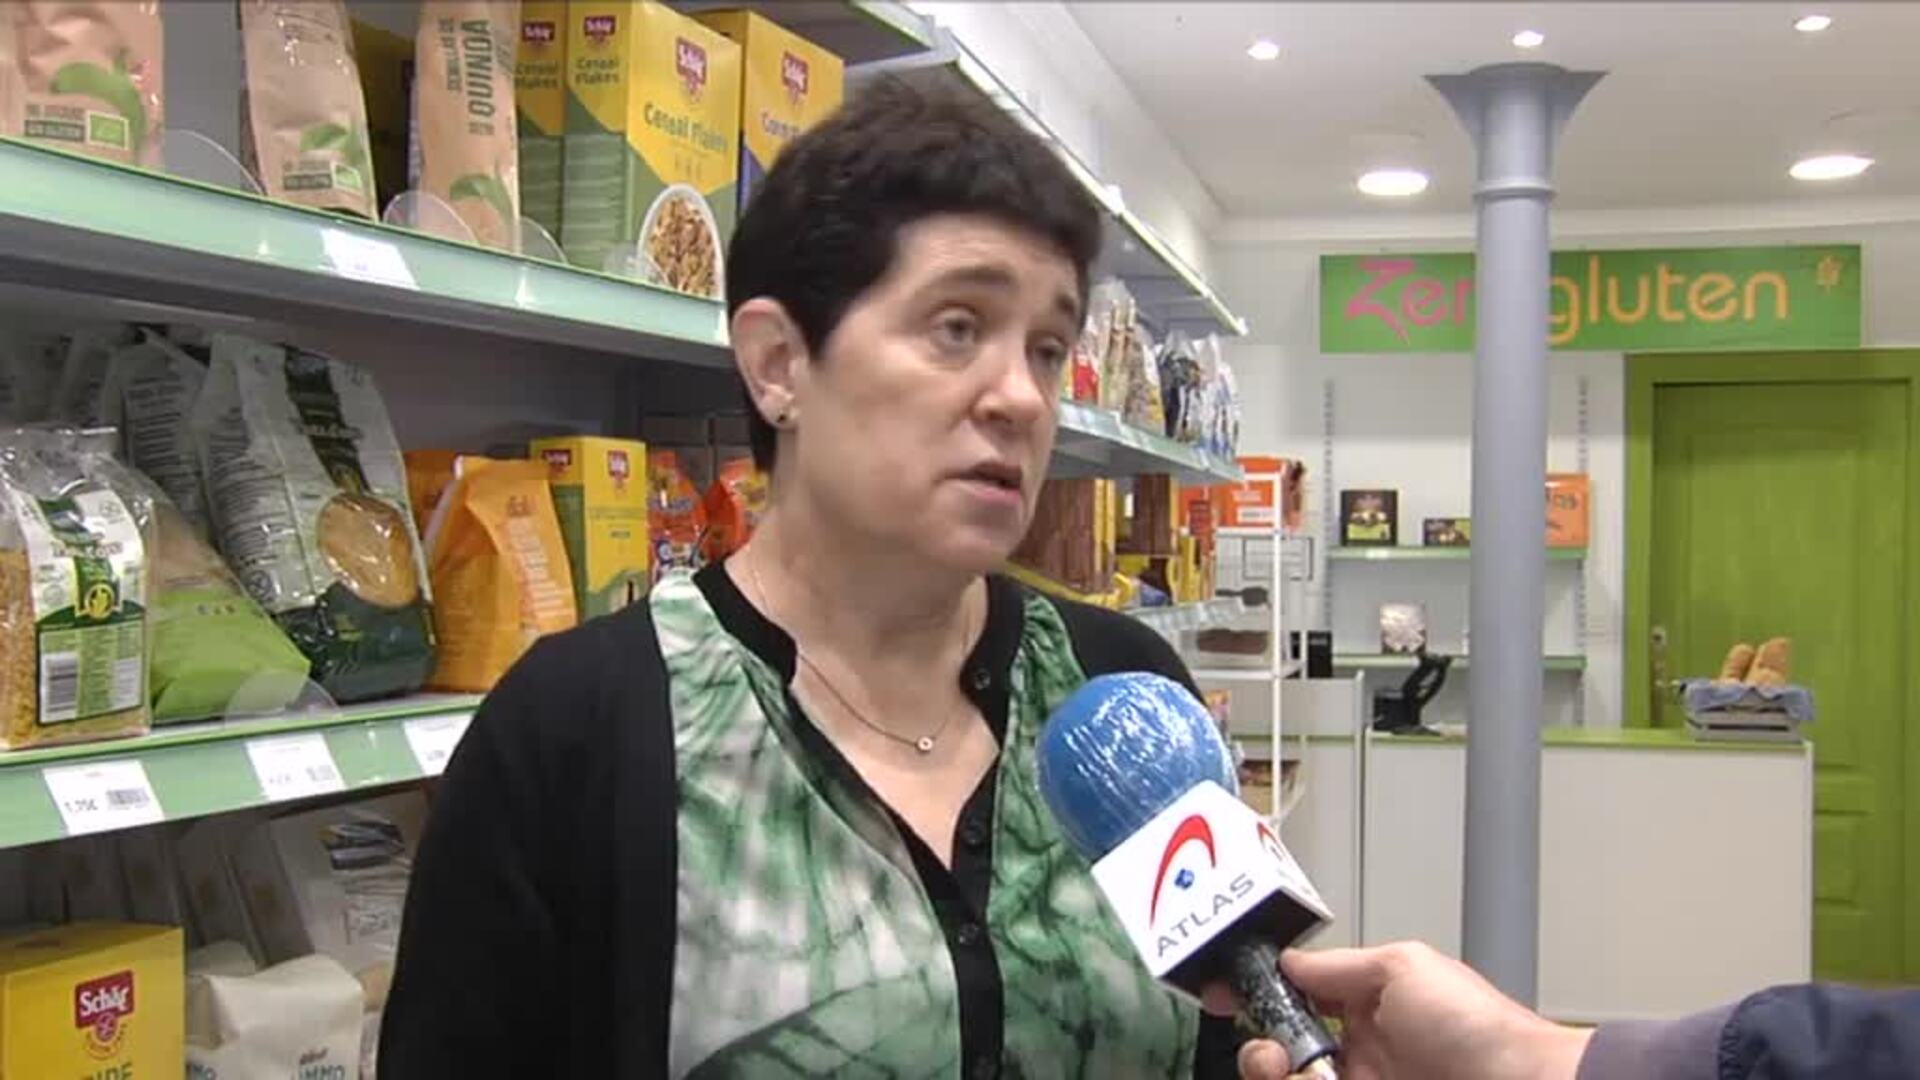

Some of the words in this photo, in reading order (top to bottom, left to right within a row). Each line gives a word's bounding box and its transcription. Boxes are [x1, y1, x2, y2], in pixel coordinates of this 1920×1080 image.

[461, 19, 495, 117] QUINOA
[575, 72, 619, 84] Flakes
[576, 56, 619, 70] Cereal
[644, 101, 690, 138] Cereal
[1344, 257, 1476, 346] Zer
[1546, 254, 1789, 345] gluten
[1158, 873, 1255, 958] ATLAS
